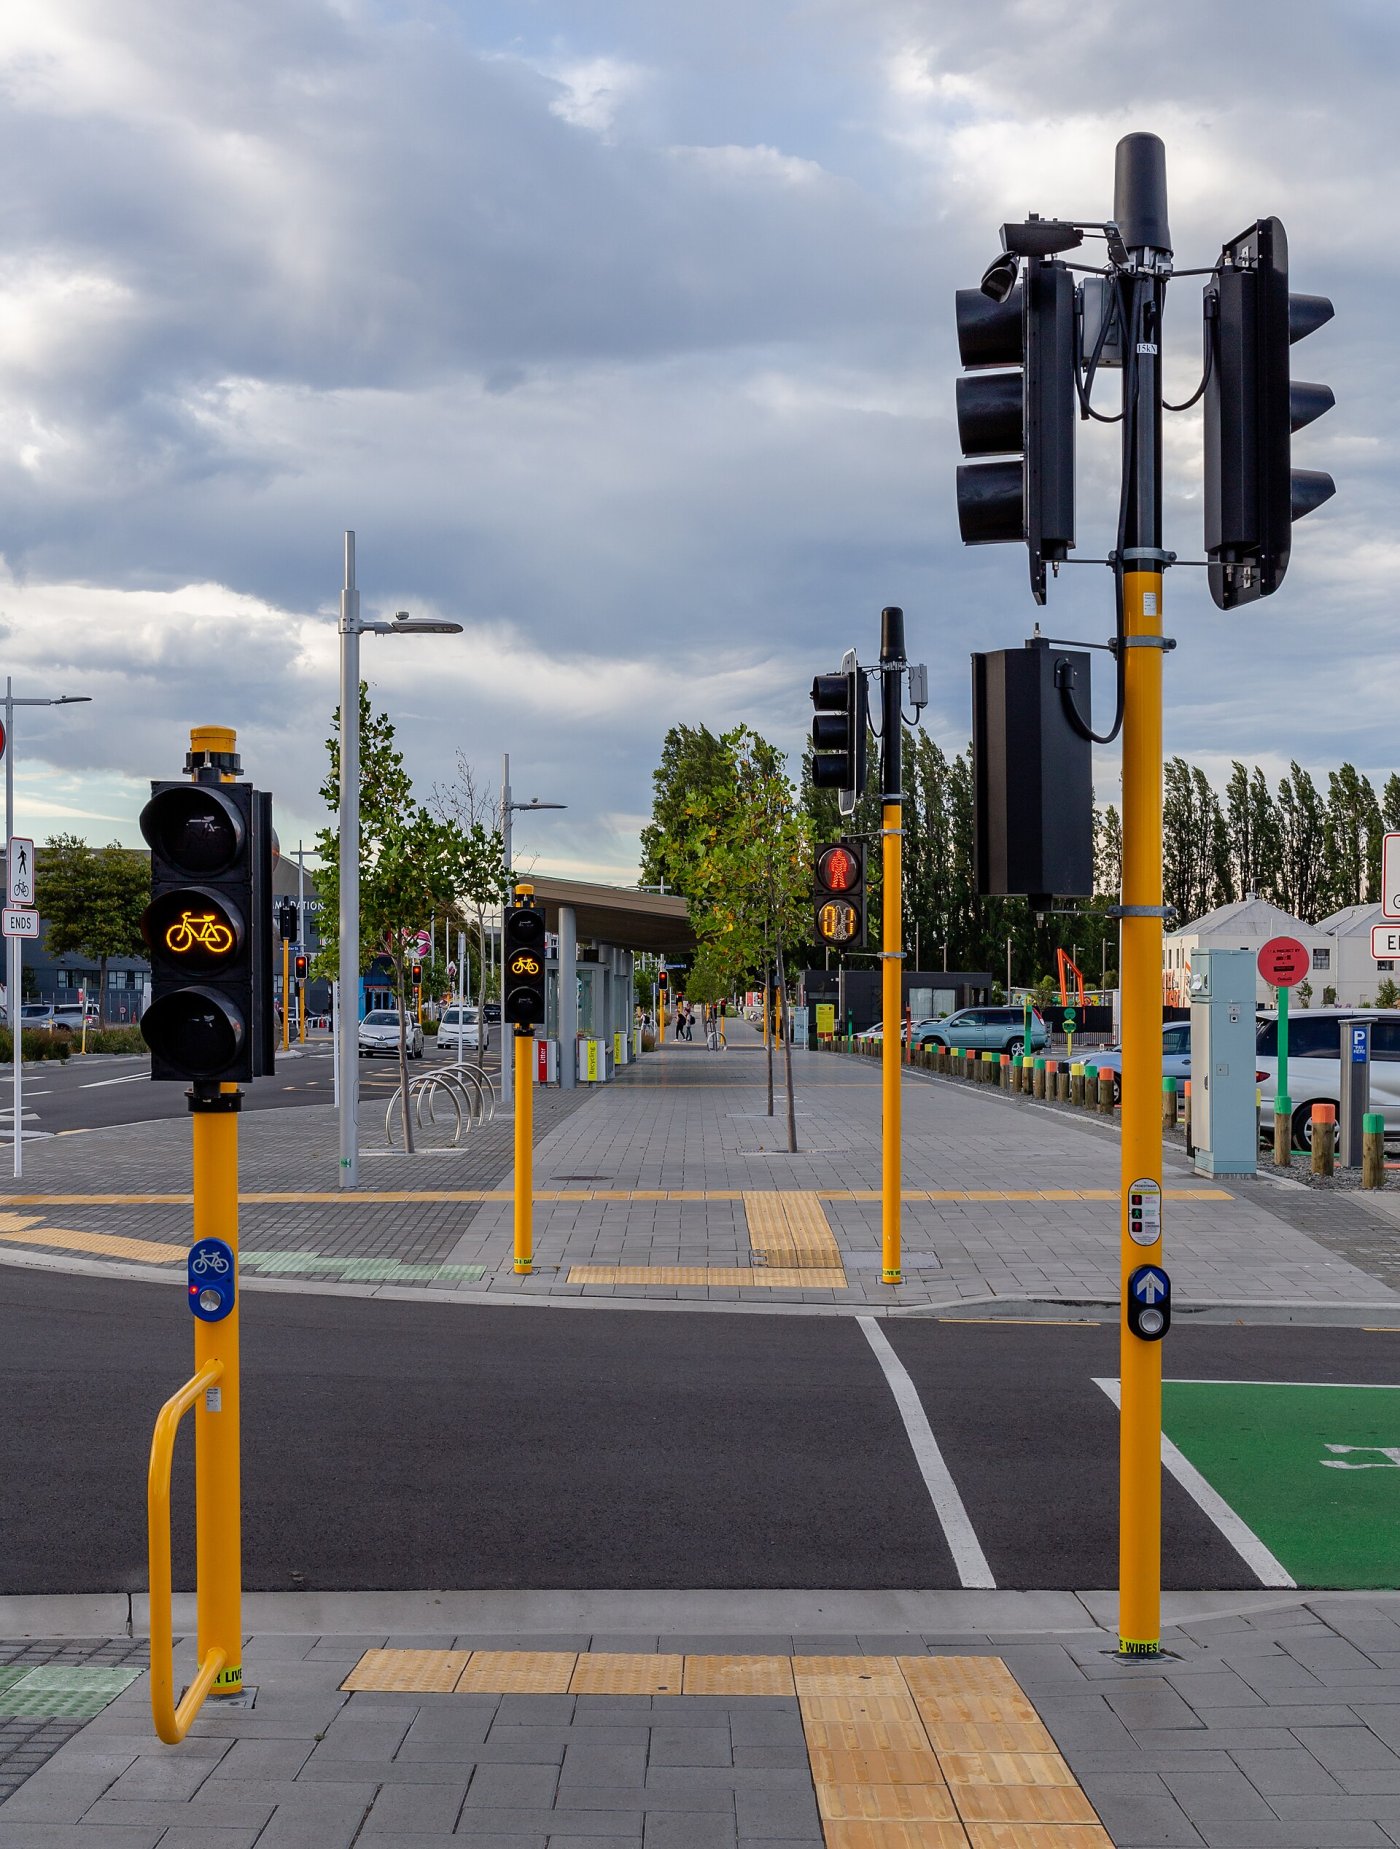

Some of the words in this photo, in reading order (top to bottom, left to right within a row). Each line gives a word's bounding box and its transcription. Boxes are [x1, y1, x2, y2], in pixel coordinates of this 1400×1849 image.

[1138, 344, 1156, 353] 15kN
[10, 916, 32, 930] ENDS
[1387, 934, 1400, 950] E
[1354, 1030, 1366, 1045] P
[539, 1047, 547, 1064] Litter
[588, 1046, 596, 1075] Recycling
[1125, 1641, 1158, 1654] WIRES
